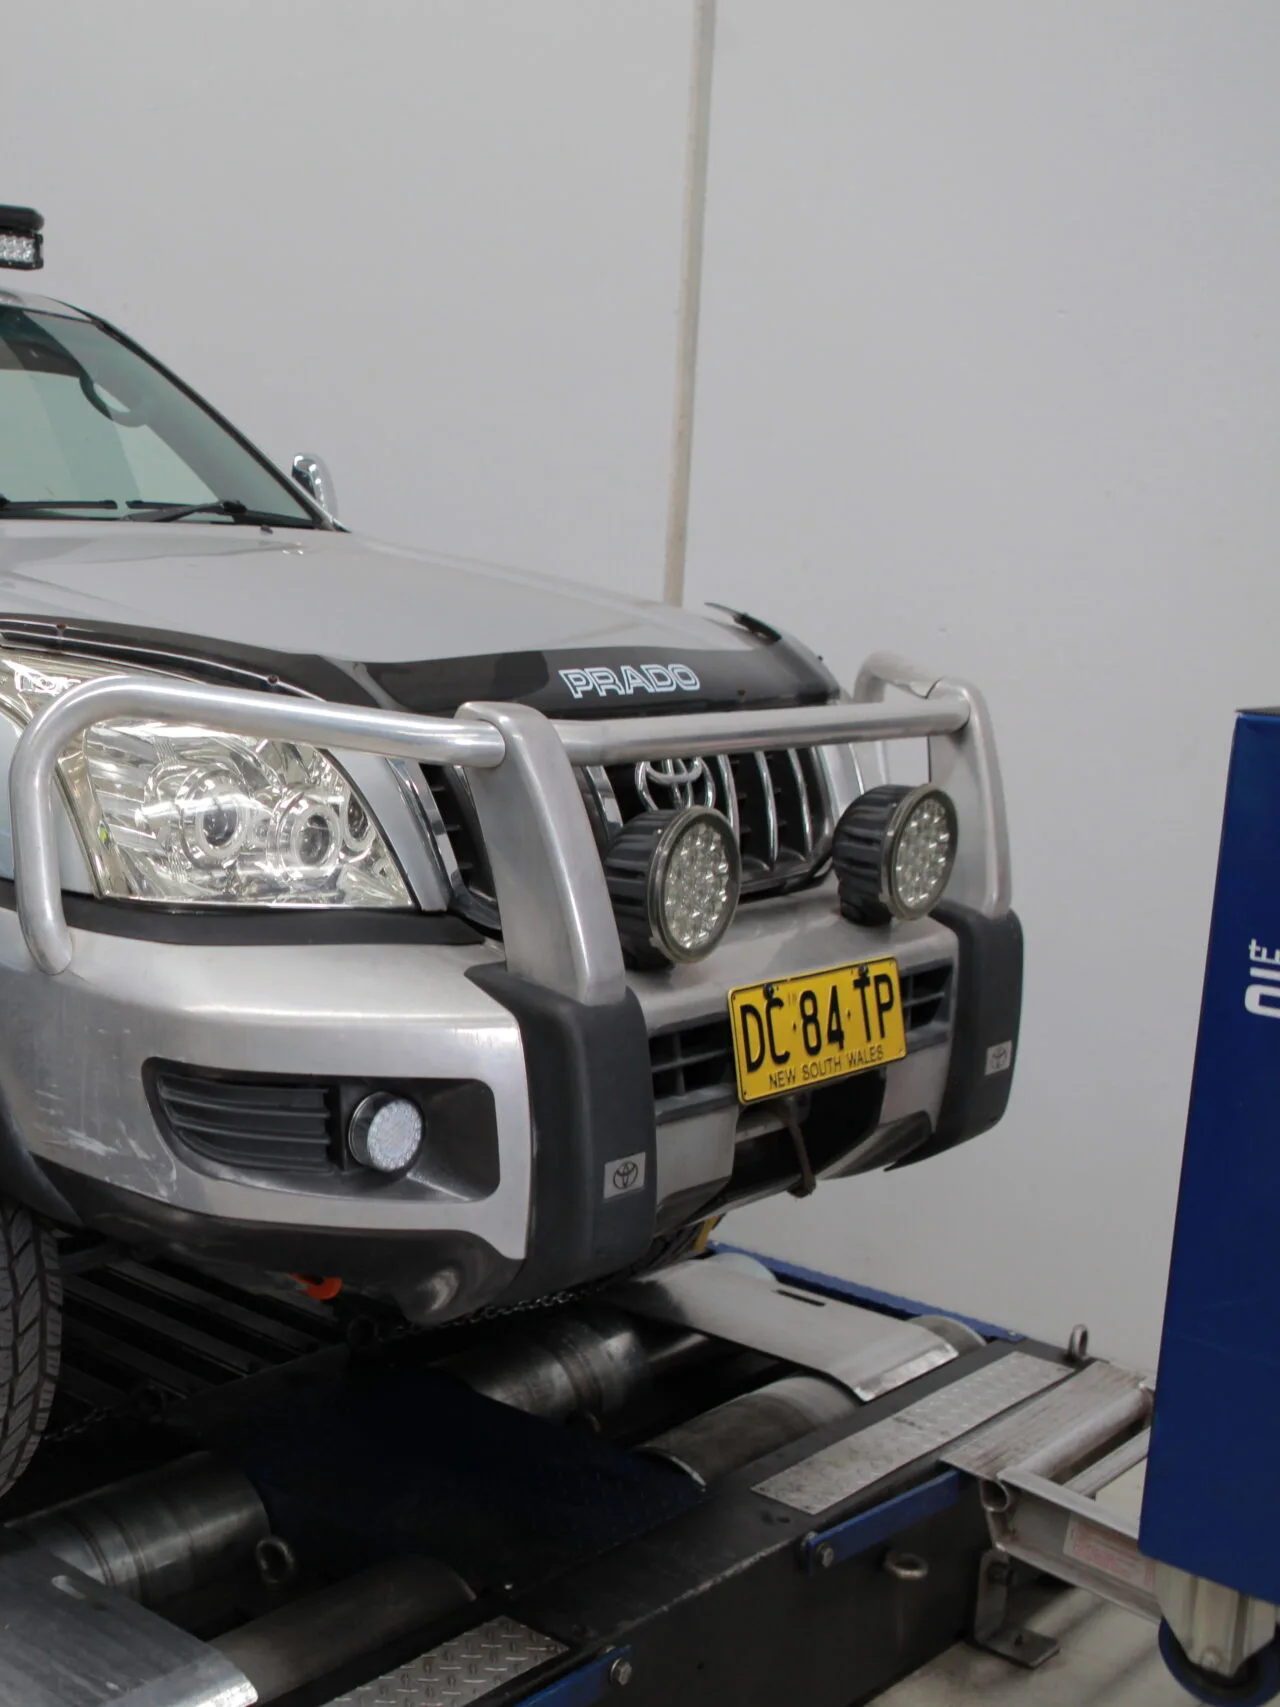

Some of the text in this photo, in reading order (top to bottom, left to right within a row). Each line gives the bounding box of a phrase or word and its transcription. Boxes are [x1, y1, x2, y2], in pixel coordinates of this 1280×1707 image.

[558, 664, 700, 699] PRADO
[769, 1044, 884, 1090] NEW SOUTH WALES
